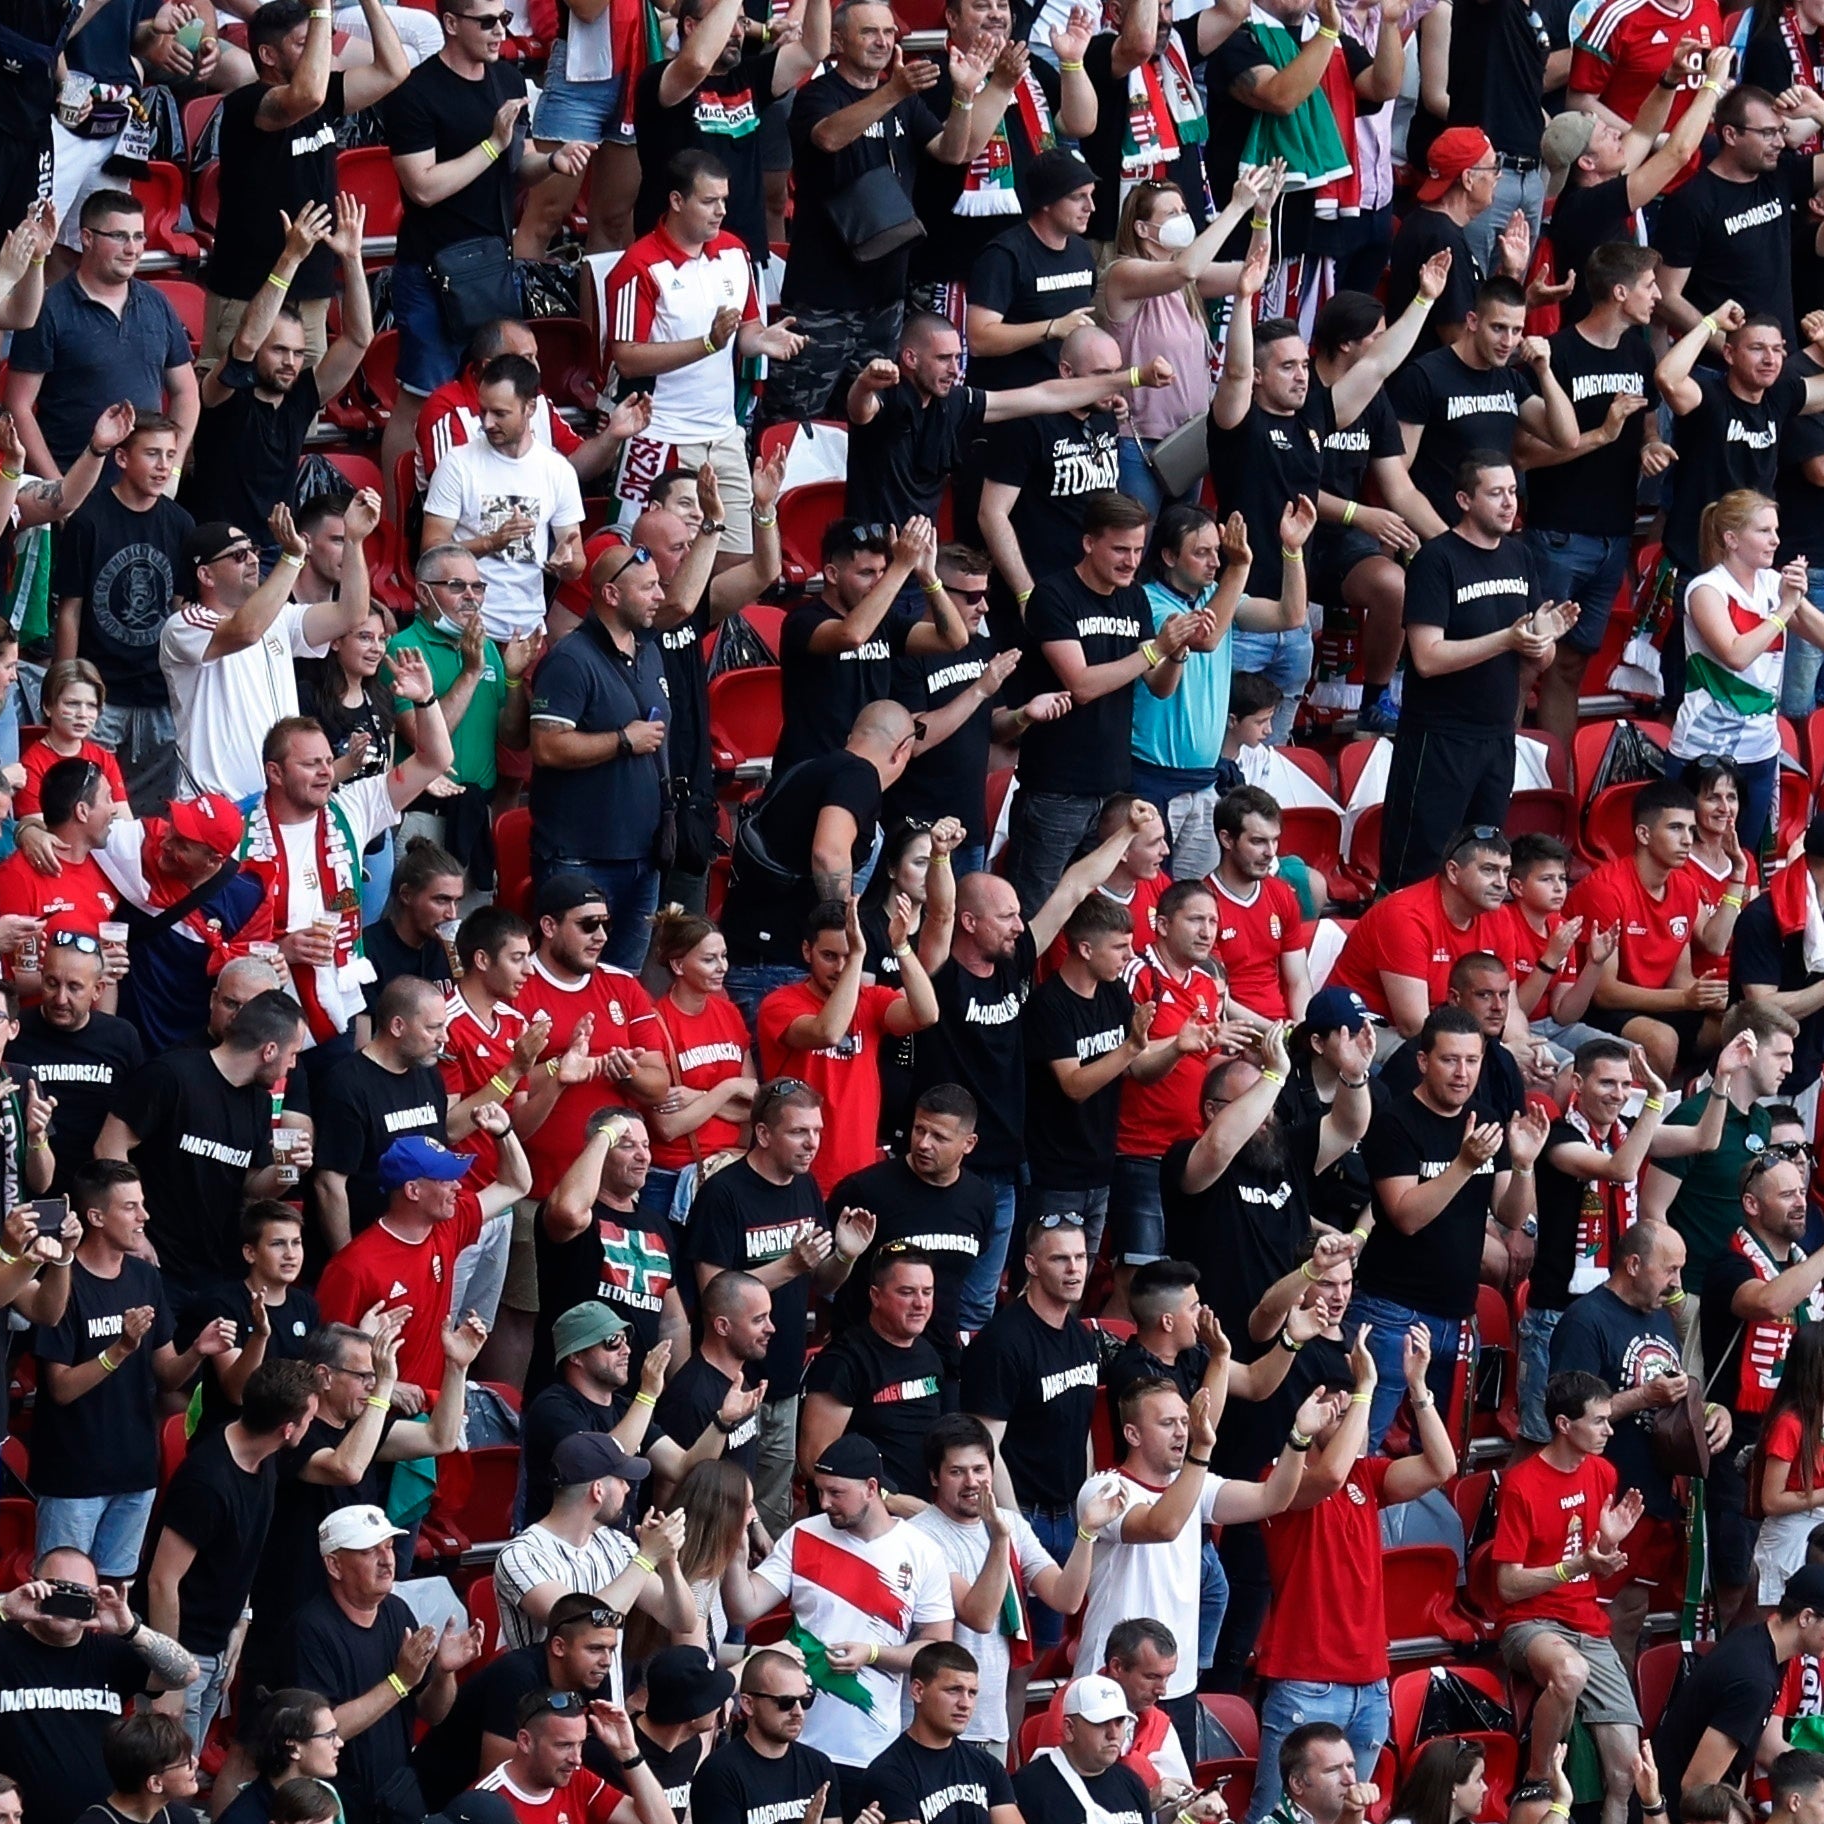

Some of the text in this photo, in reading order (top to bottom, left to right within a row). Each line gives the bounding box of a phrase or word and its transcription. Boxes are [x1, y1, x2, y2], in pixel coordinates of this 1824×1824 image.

[1447, 390, 1518, 421] MAGYARORSZÁG
[32, 1062, 111, 1084] GYARORSZÁG
[178, 1133, 252, 1169] MAGYARORSZÁ
